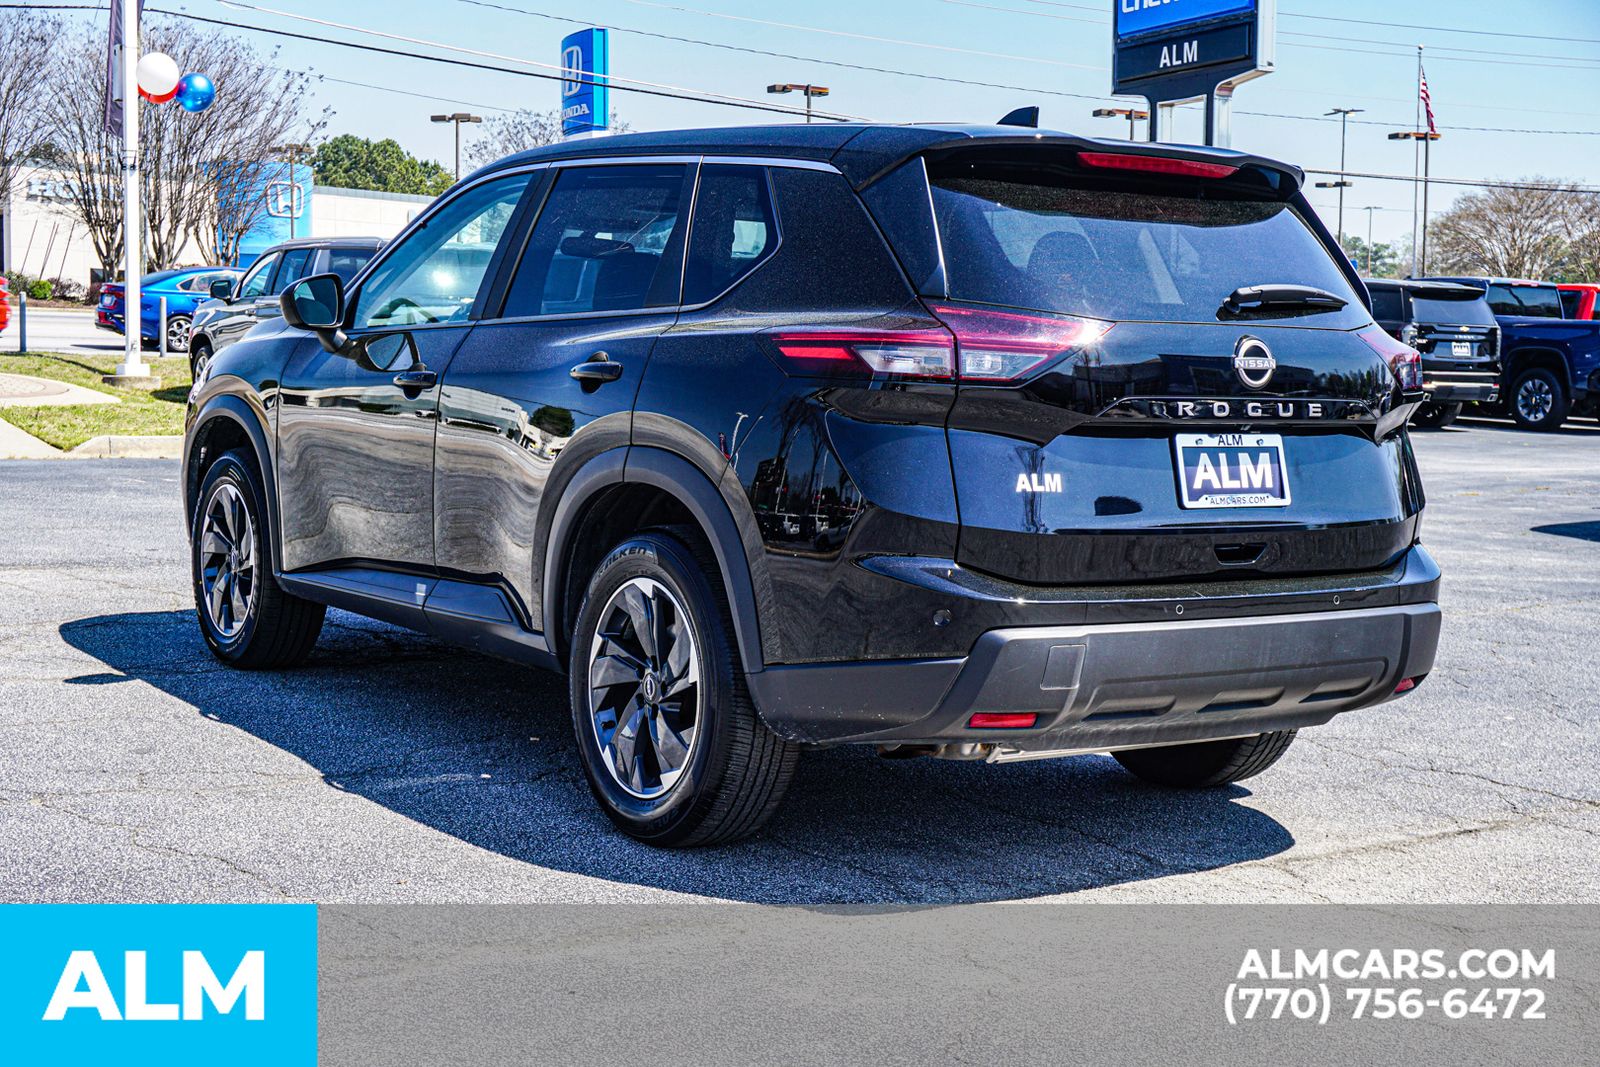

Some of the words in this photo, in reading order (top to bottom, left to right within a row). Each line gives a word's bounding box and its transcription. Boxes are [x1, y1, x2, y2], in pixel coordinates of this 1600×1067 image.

[1159, 40, 1198, 68] ALM
[1235, 359, 1276, 368] NISSAN
[1178, 402, 1322, 417] ROGUE
[1217, 434, 1243, 446] ALM
[1193, 452, 1274, 489] ALM
[1015, 473, 1062, 493] ALM
[1210, 496, 1266, 505] ALMCARS.COM
